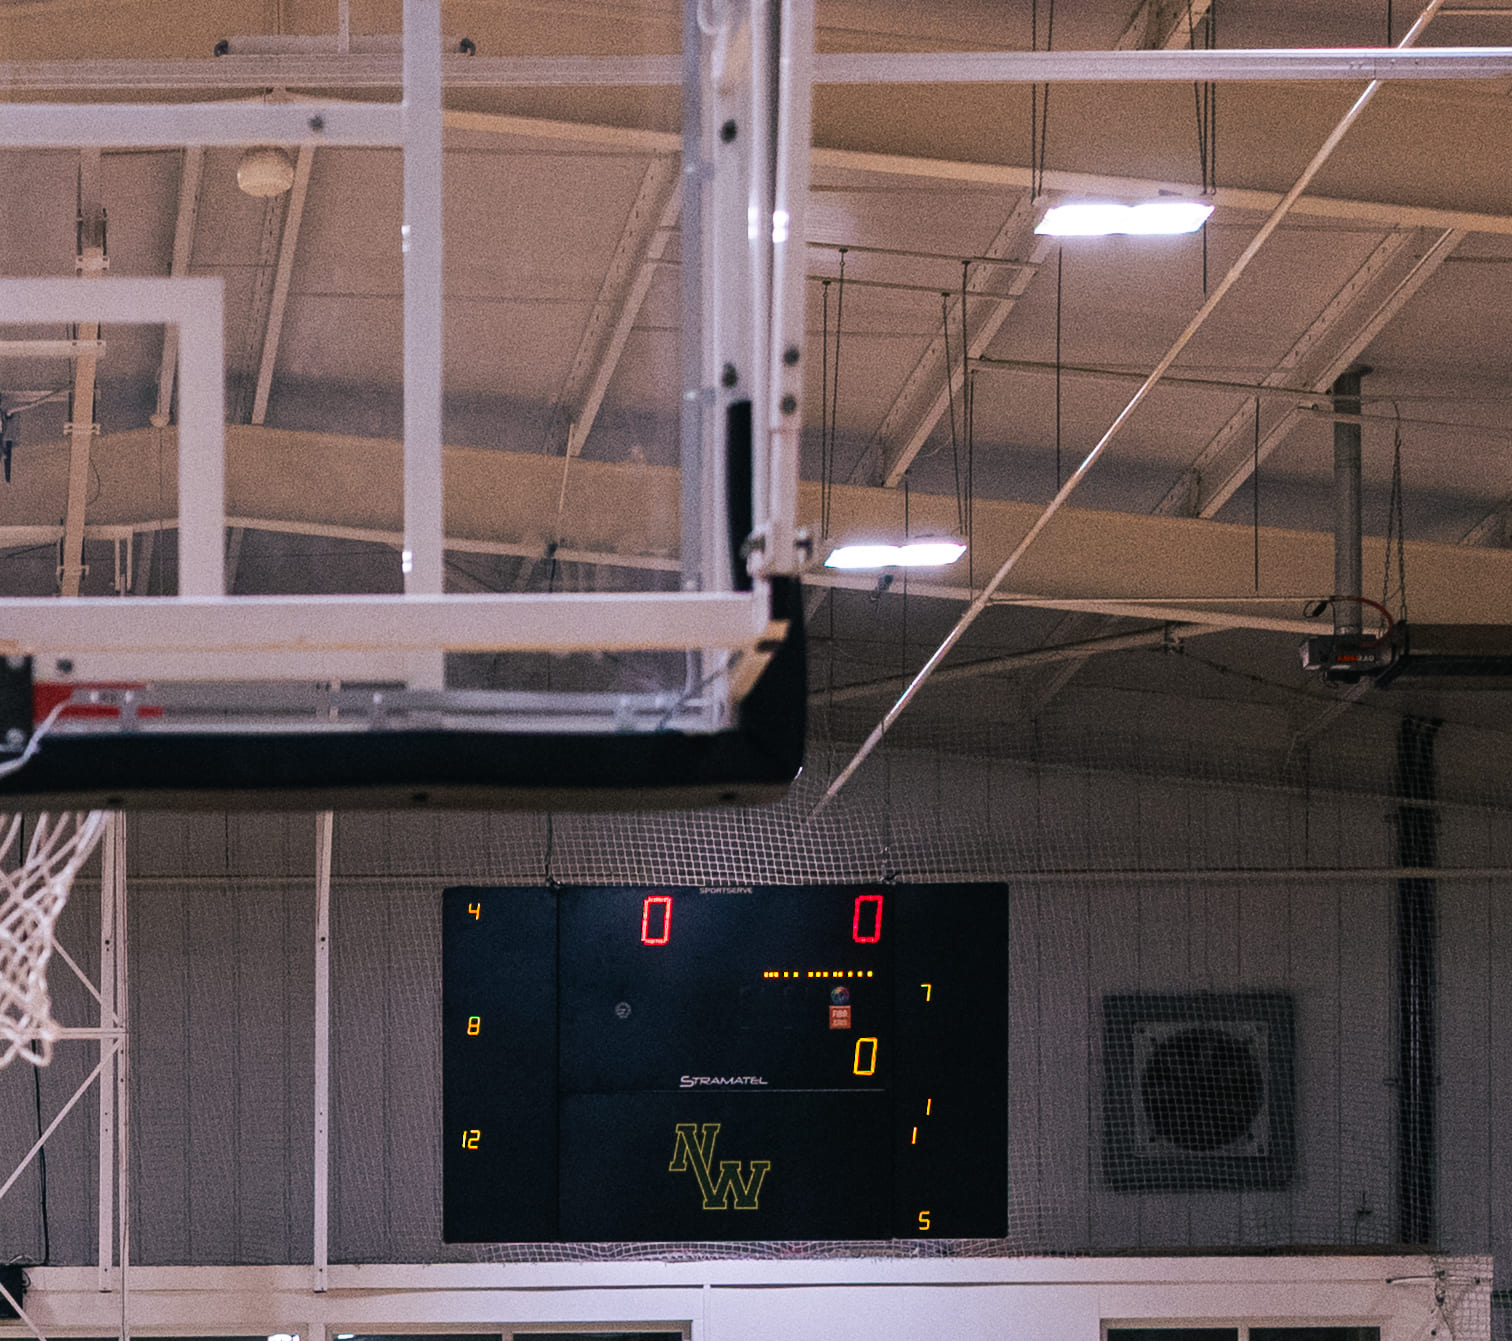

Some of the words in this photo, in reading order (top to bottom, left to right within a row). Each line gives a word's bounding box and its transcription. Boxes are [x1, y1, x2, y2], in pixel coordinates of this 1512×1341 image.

[468, 903, 481, 920] 4
[641, 896, 673, 945] 0
[853, 895, 883, 943] 0
[920, 984, 932, 1002] 7
[467, 1016, 481, 1036] 8
[853, 1037, 878, 1075] 0
[461, 1130, 481, 1150] 12
